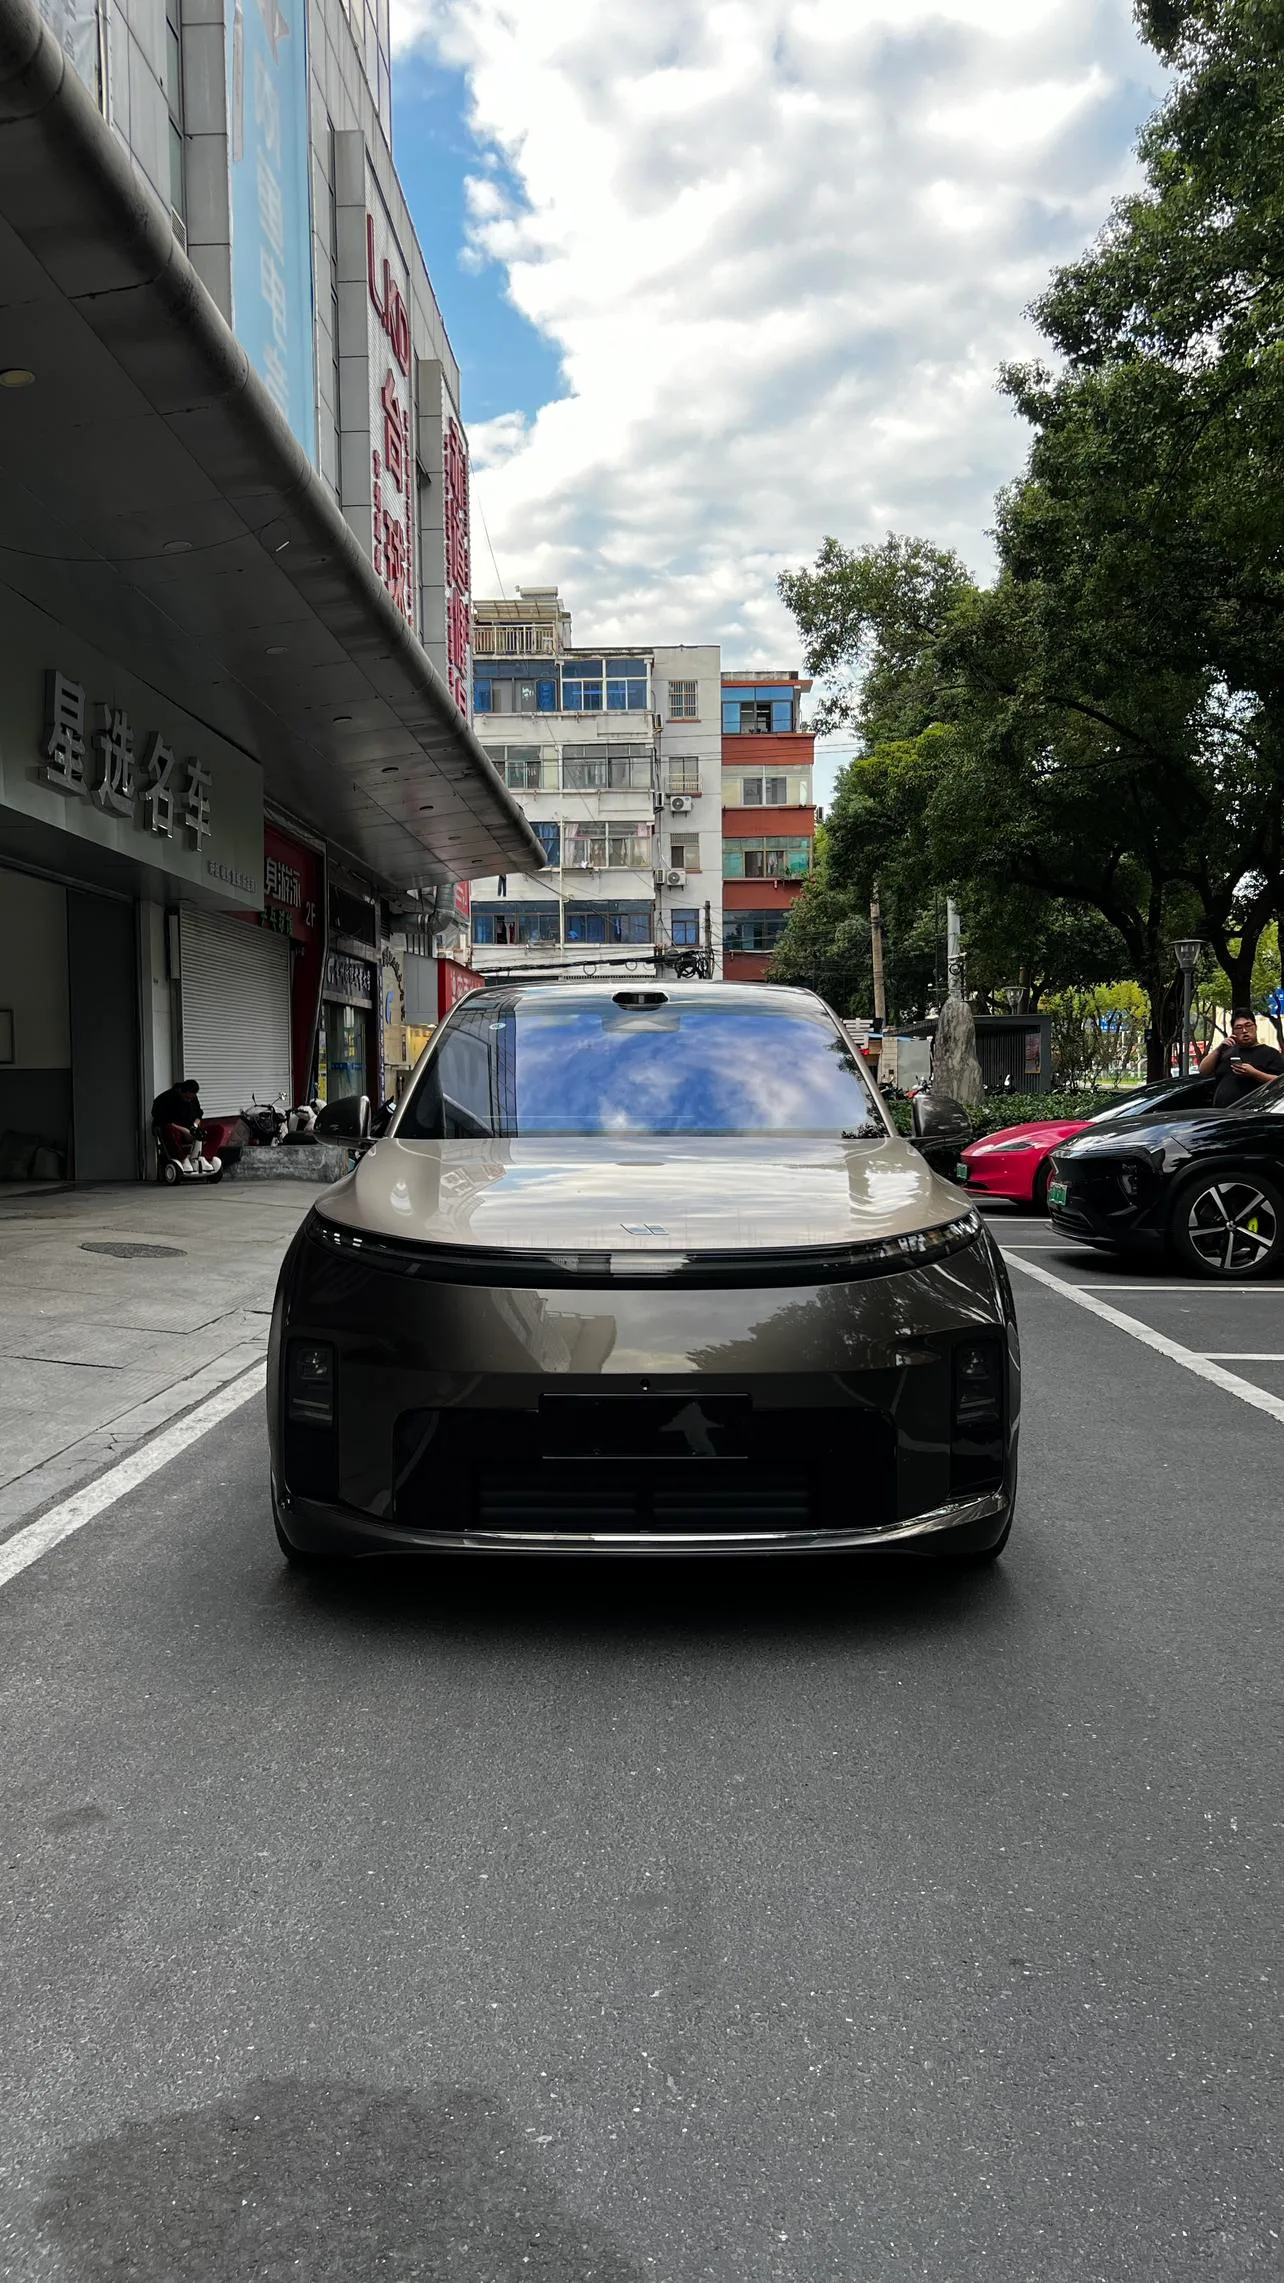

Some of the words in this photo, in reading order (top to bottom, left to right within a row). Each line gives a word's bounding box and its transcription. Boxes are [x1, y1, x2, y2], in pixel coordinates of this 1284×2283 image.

[367, 214, 411, 377] LKD
[46, 669, 213, 852] 星选名车
[306, 900, 316, 928] 2F
